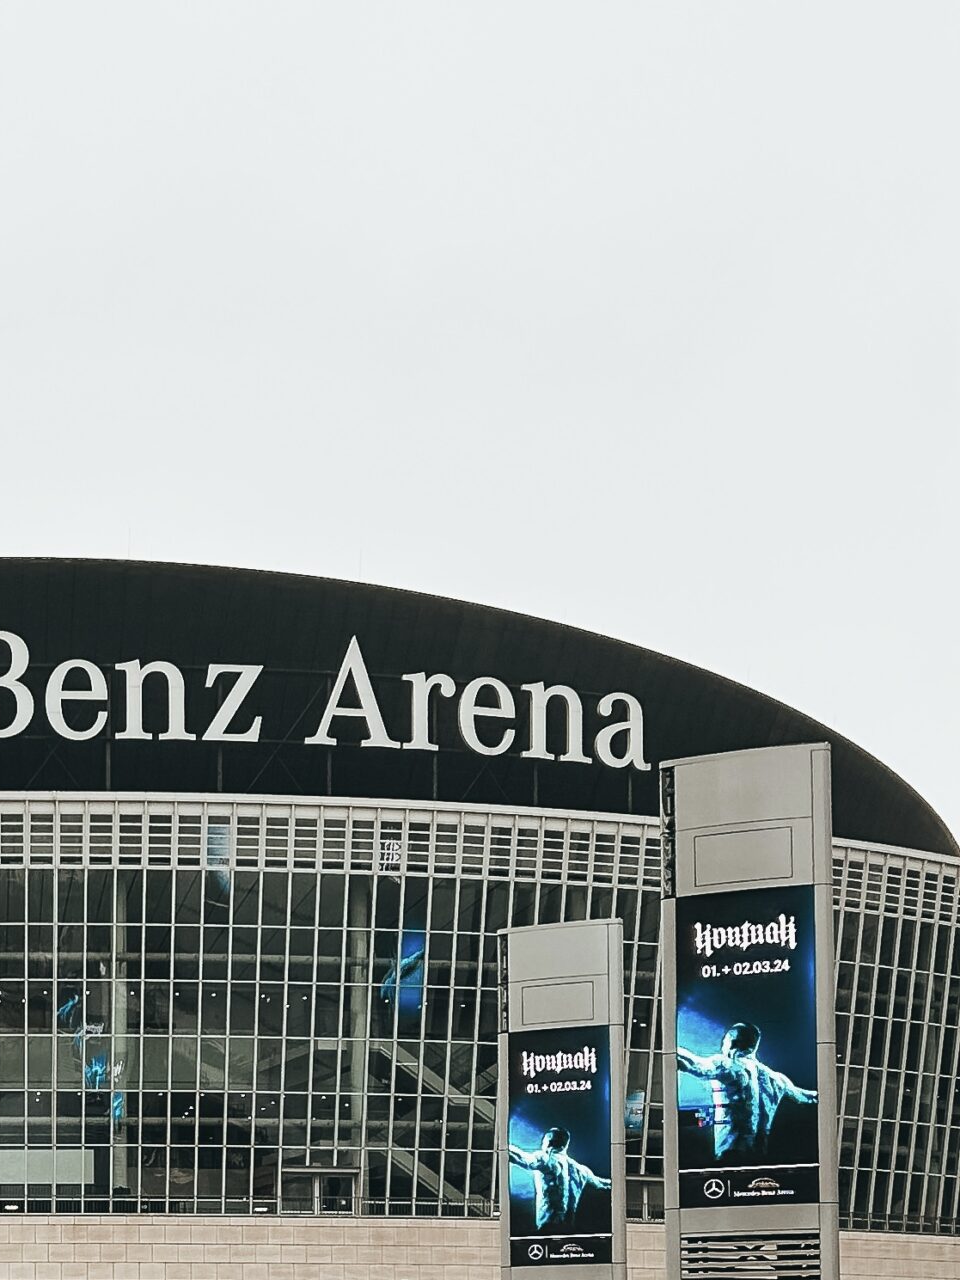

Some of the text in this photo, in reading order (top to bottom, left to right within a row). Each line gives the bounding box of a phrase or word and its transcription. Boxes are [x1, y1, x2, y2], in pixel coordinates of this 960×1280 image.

[303, 634, 651, 771] Arena
[733, 959, 791, 975] 02.03.24
[549, 1080, 592, 1092] 02.03.24
